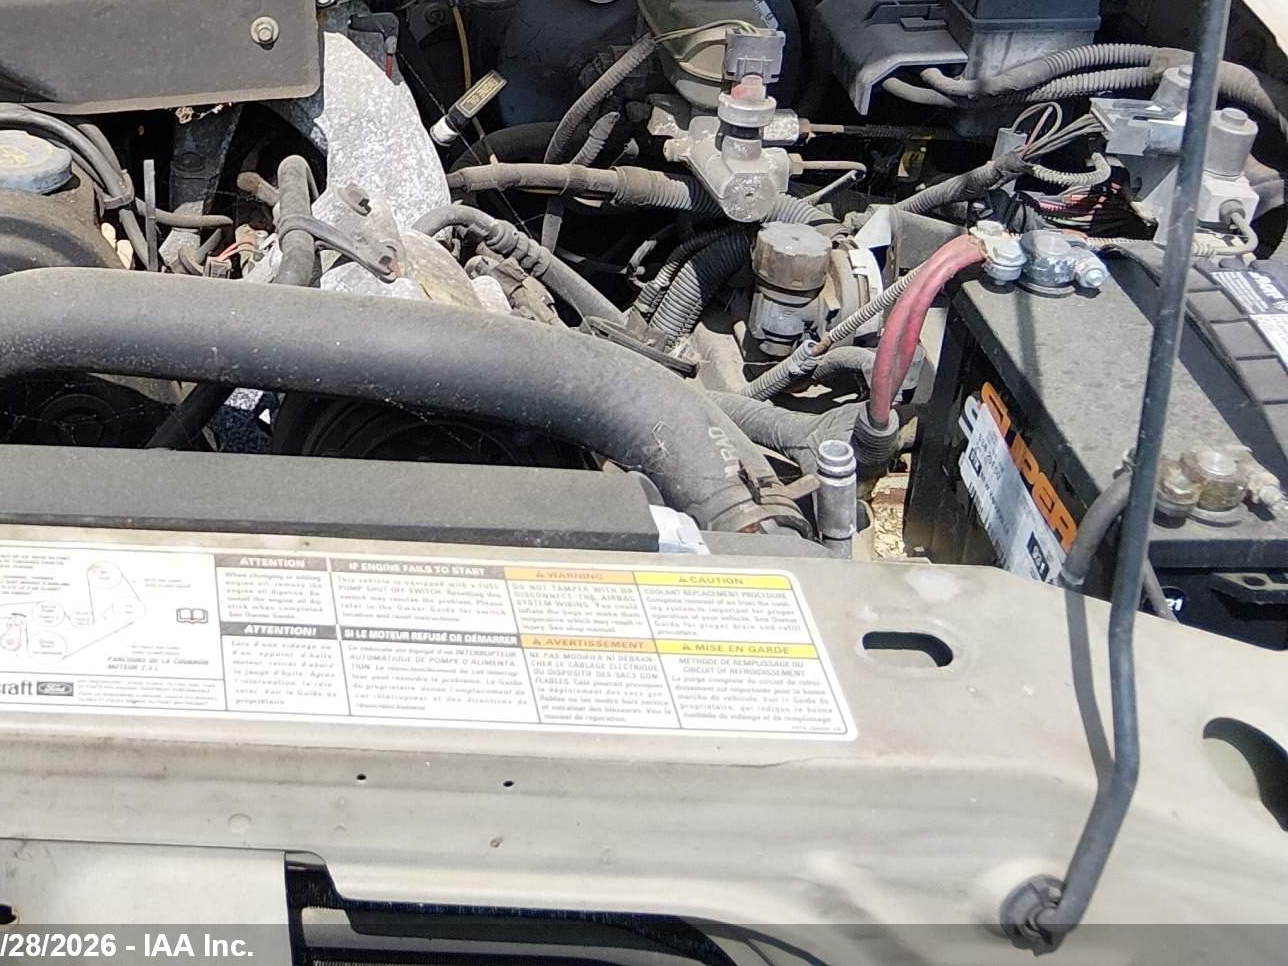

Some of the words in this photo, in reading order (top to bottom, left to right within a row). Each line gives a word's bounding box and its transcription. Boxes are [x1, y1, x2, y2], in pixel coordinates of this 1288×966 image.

[238, 557, 305, 567] ATTENTION
[348, 562, 357, 570] IF
[360, 562, 401, 572] ENGINE
[402, 564, 432, 573] FAILS
[433, 565, 450, 574] TO
[451, 566, 486, 575] START
[545, 571, 604, 580] WARNING
[688, 576, 744, 584] CAUTION
[244, 624, 317, 635] ATTENTION!
[343, 627, 354, 638] SI
[355, 627, 367, 639] LE
[367, 628, 410, 640] MOTEUR
[448, 631, 463, 642] DE
[544, 637, 646, 649] AVERTISSEMENT
[693, 643, 724, 652] MISE
[726, 644, 745, 653] EN
[746, 645, 792, 654] GARDE
